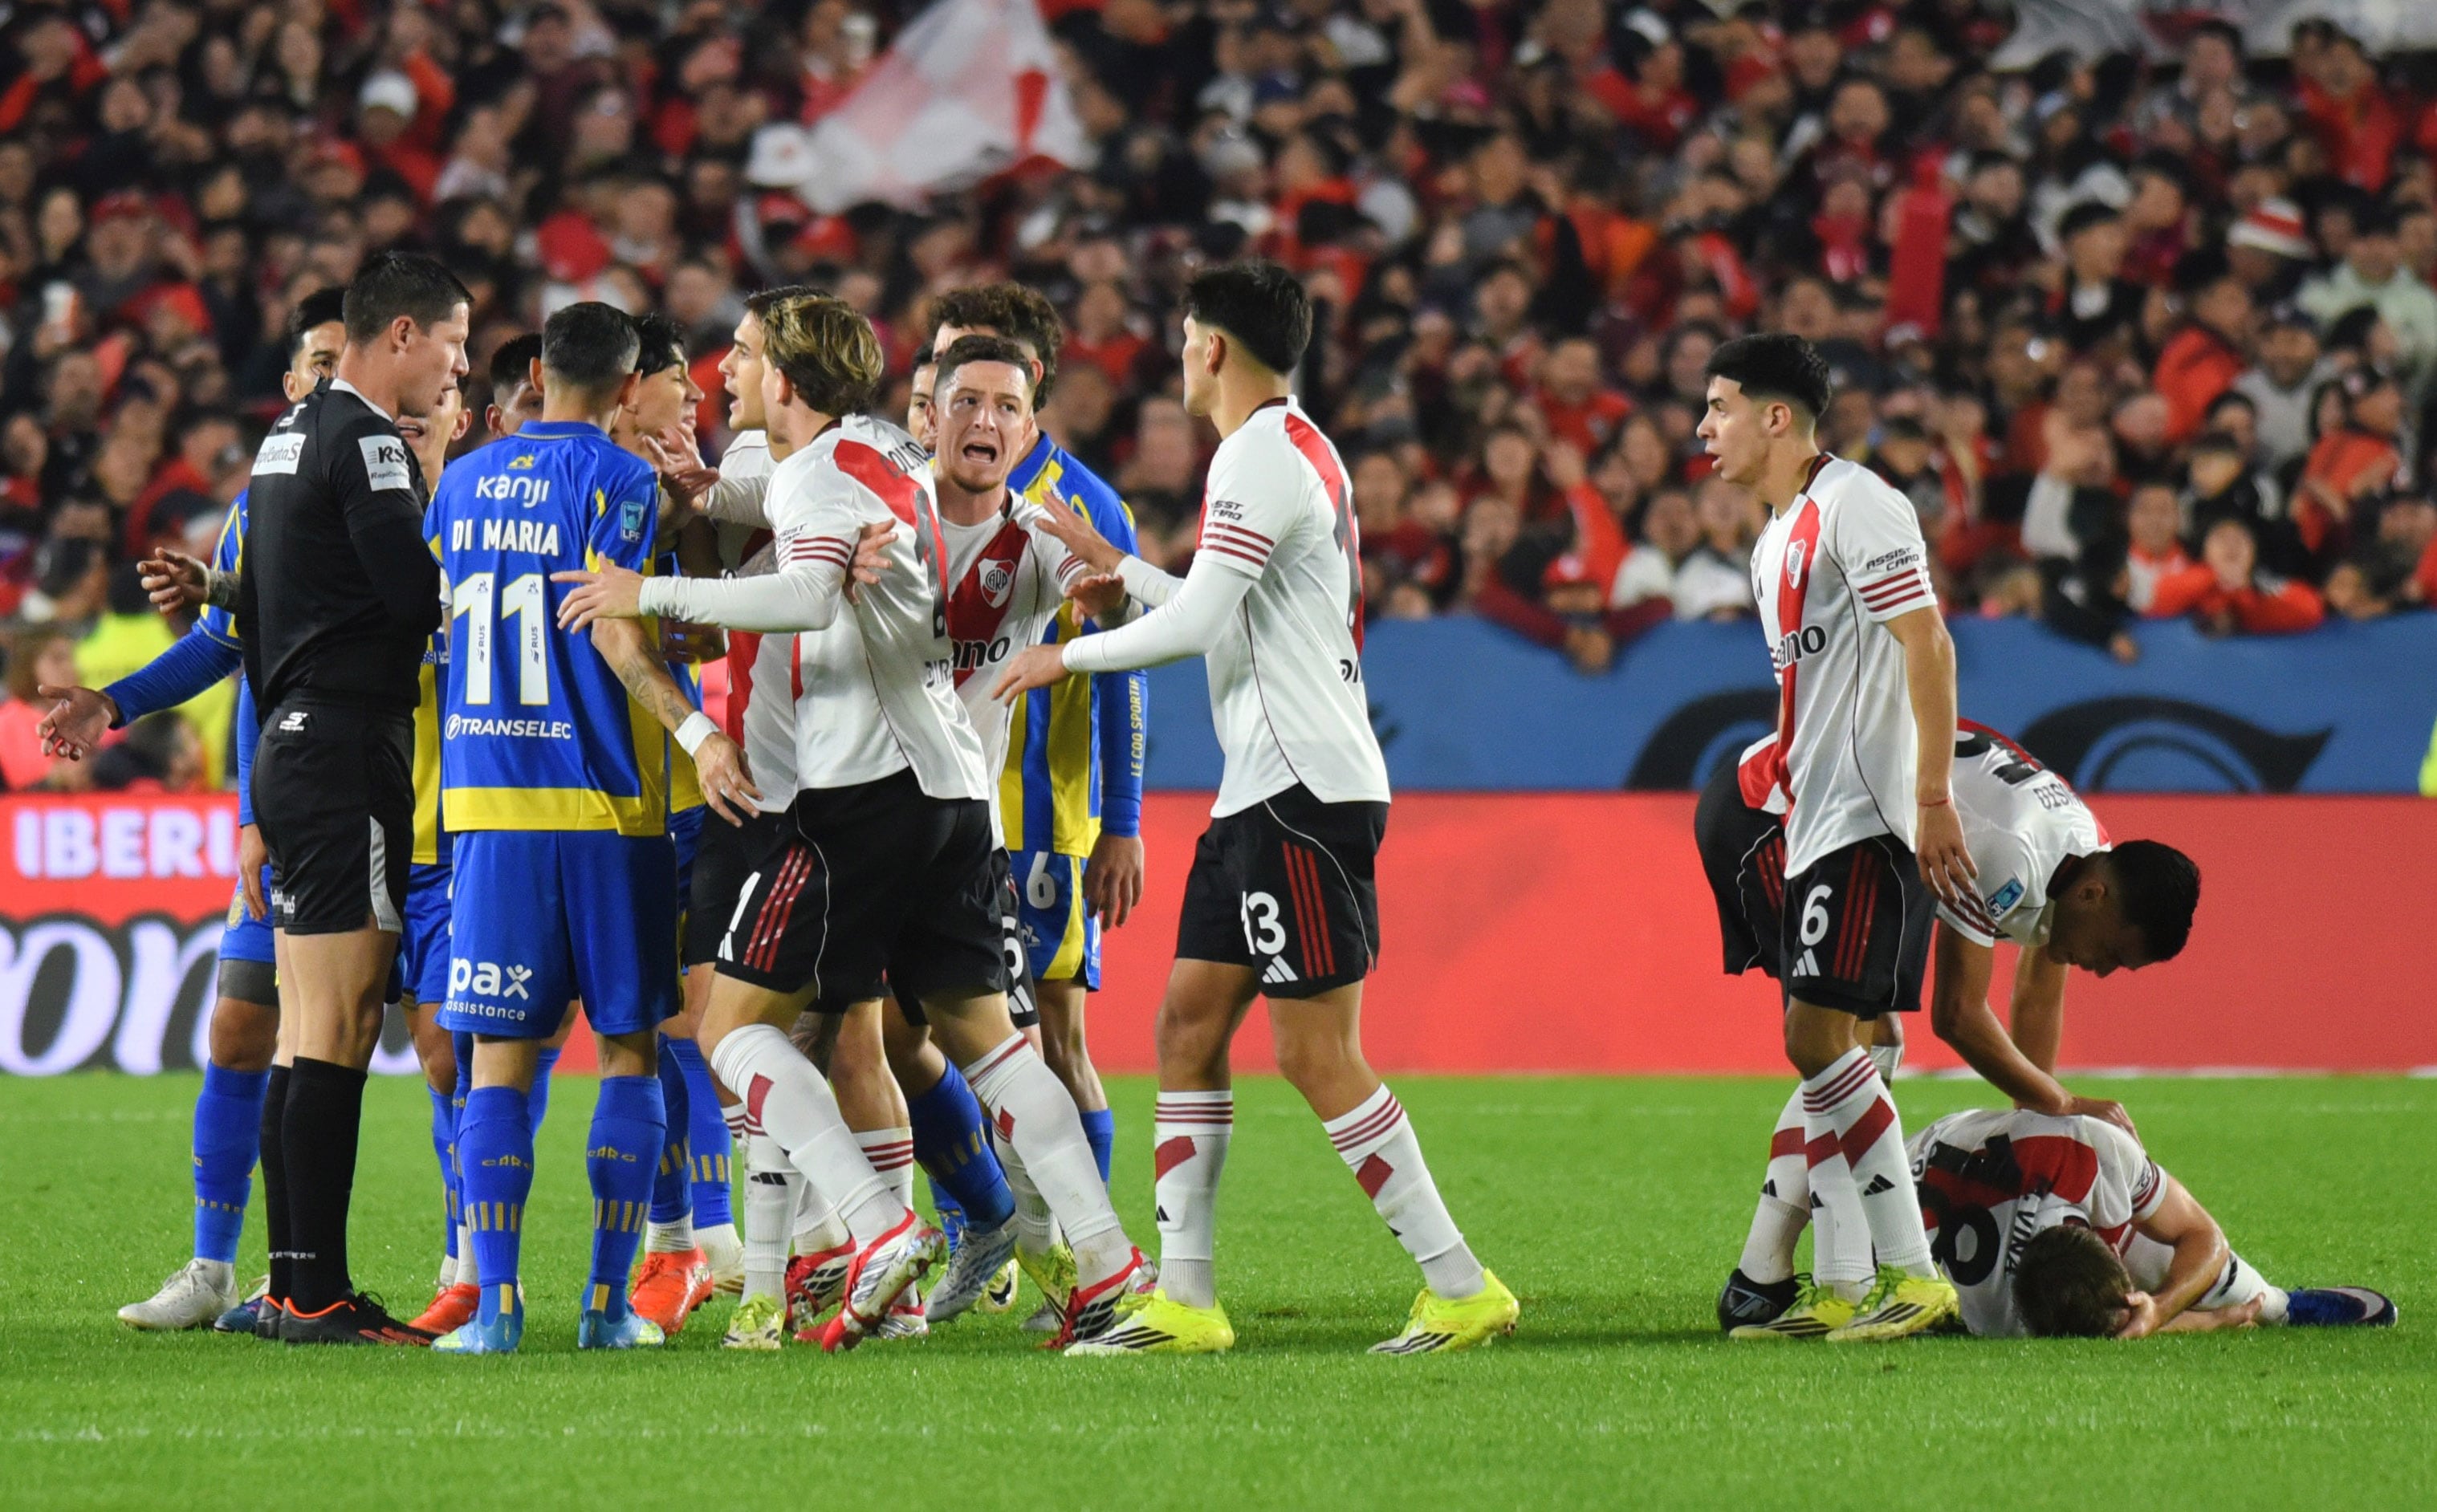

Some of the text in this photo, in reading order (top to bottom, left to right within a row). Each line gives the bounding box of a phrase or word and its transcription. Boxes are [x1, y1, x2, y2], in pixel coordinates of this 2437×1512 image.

[452, 518, 559, 556] DI MARIA
[1866, 547, 1911, 571] ASSIST
[1886, 554, 1920, 571] CARD
[453, 572, 549, 705] 11
[1776, 625, 1826, 668] ano
[1129, 677, 1142, 730] SPORTIF
[460, 718, 572, 740] TRANSELEC
[1131, 761, 1142, 777] LE
[1027, 852, 1056, 909] 6
[1241, 890, 1286, 955] 13
[1800, 884, 1833, 946] 6
[448, 957, 533, 1001] pax
[446, 1000, 527, 1021] assistance
